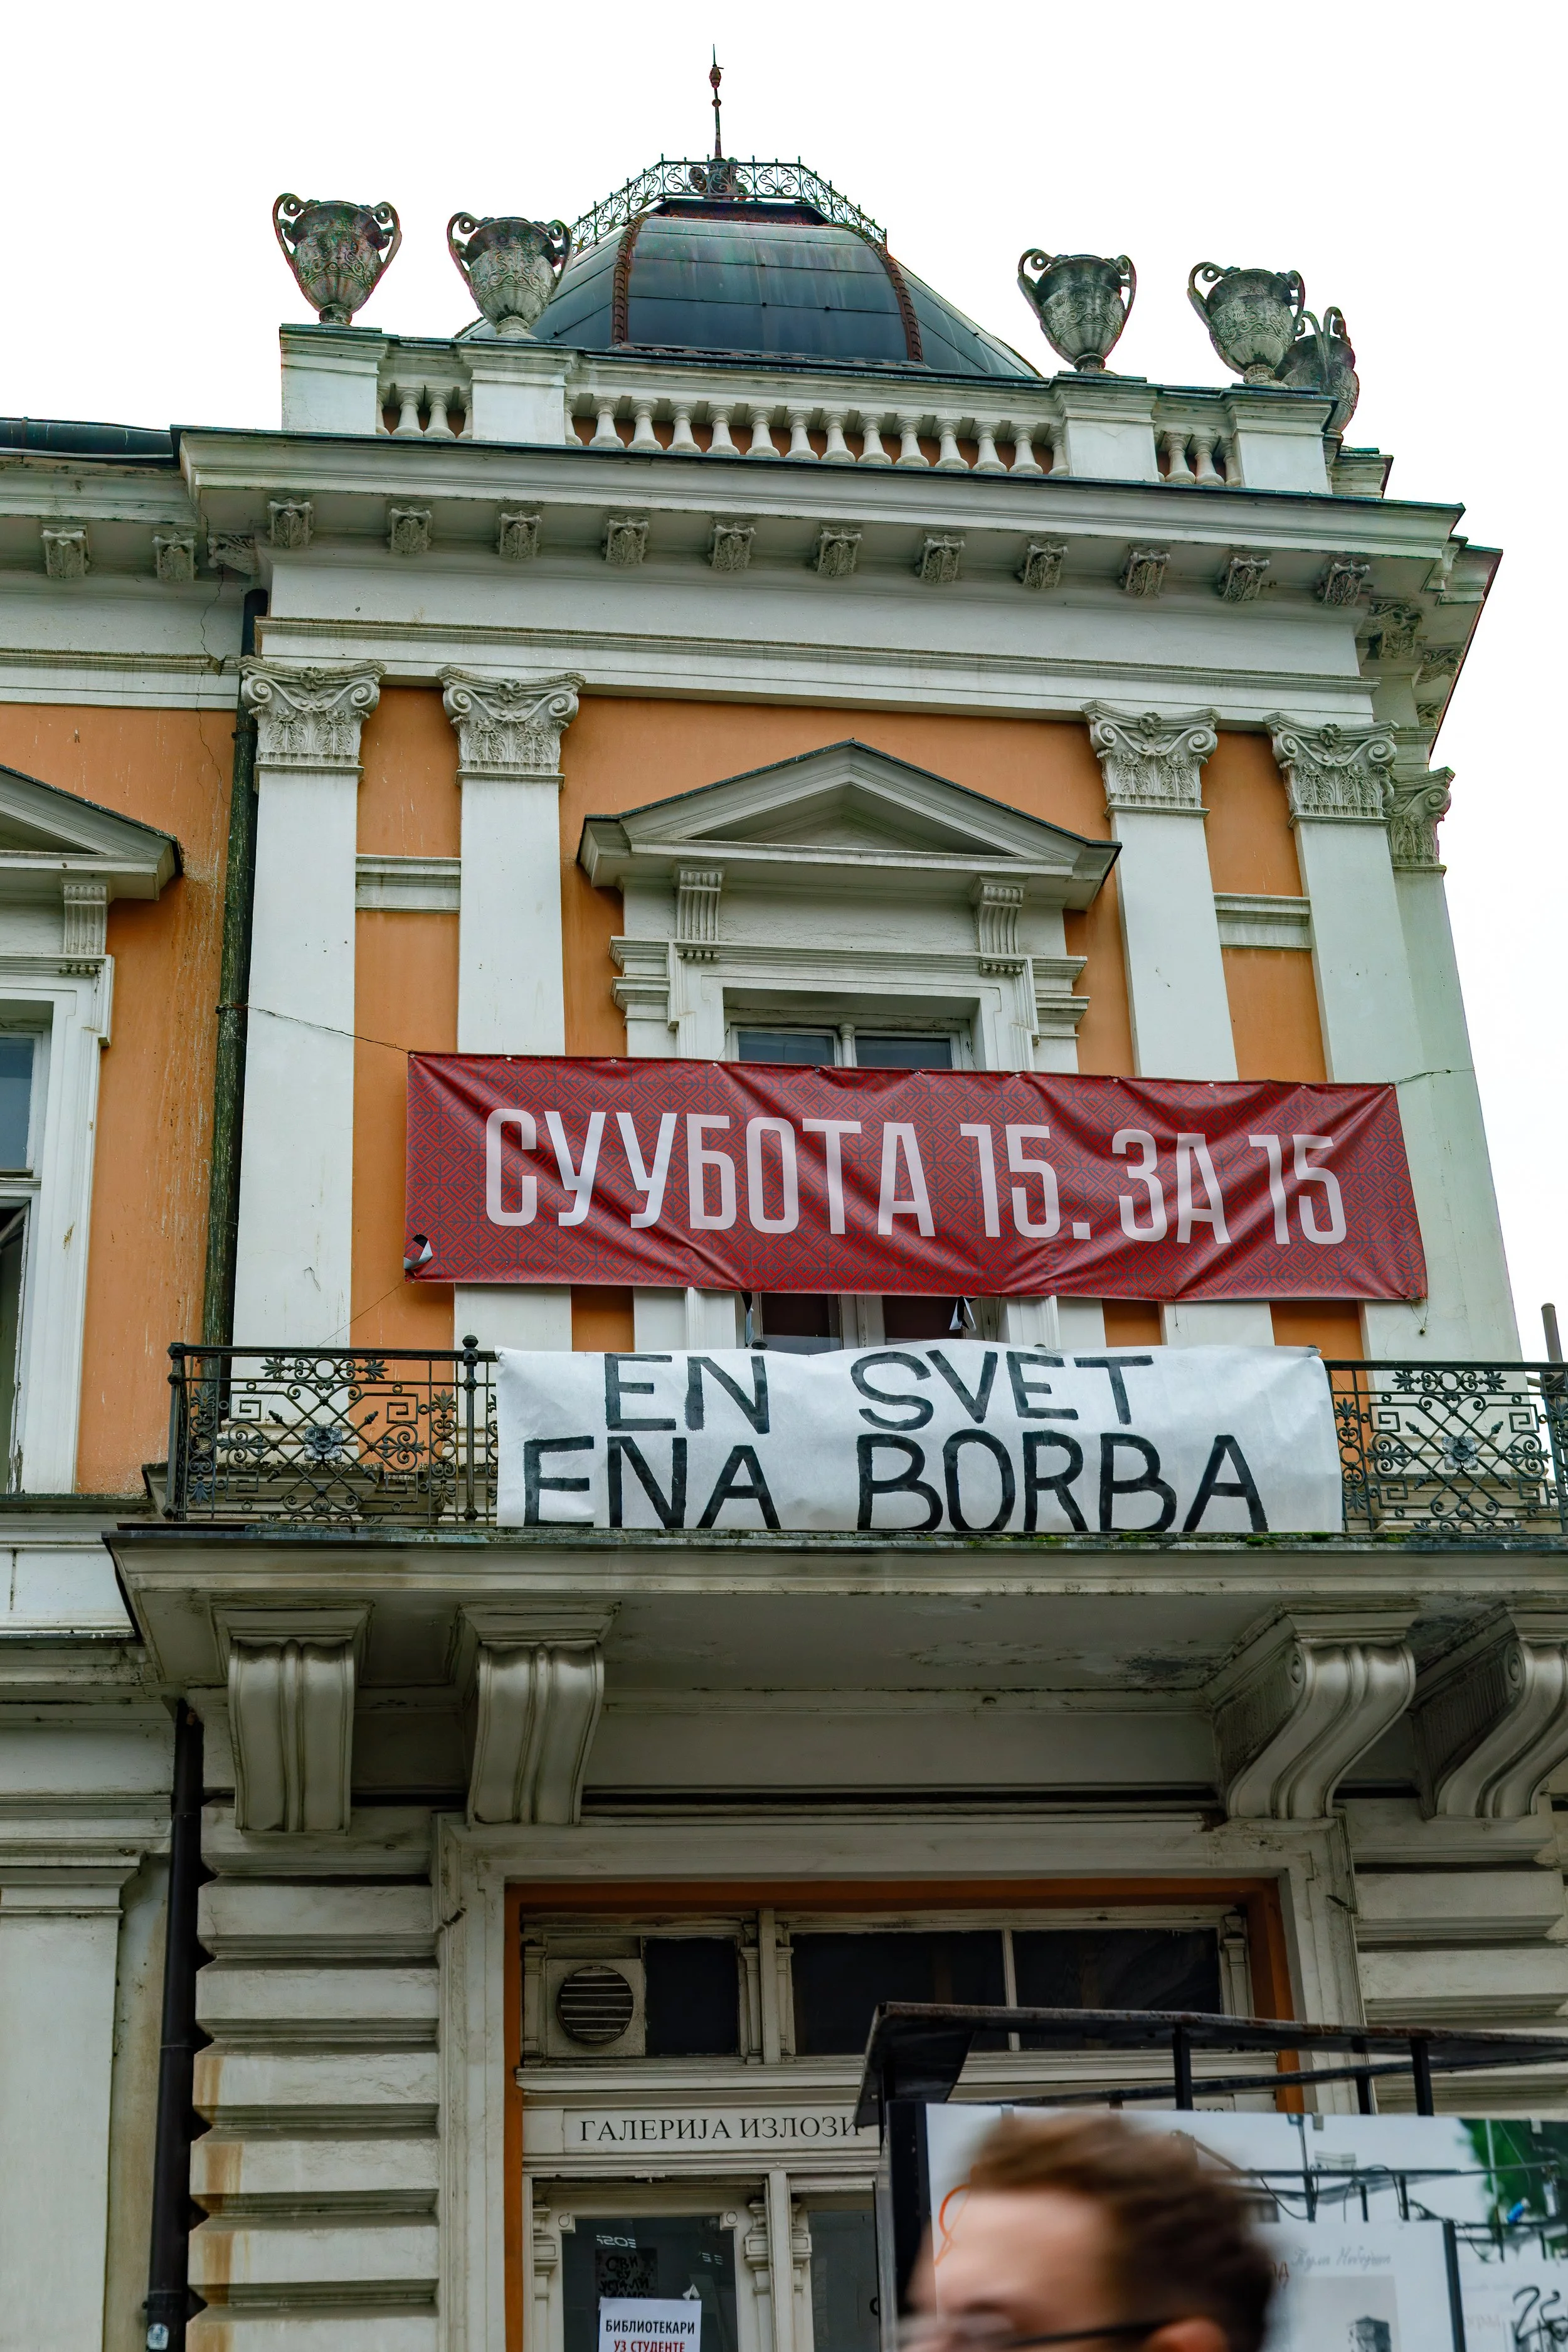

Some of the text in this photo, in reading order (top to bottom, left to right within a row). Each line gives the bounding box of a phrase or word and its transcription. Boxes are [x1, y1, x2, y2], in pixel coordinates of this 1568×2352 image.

[485, 1108, 1348, 1245] СУУБОТА 15. ЗА 15
[604, 1350, 1153, 1434] EN SVET
[523, 1428, 1270, 1534] ENA BORBA
[580, 2116, 861, 2141] ГАЛЕРИЈА ИЗЛОЗИ
[605, 2319, 695, 2334] БИБЛИОТЕКАРИ
[613, 2340, 685, 2352] УЗ СТУДЕНТЕ
